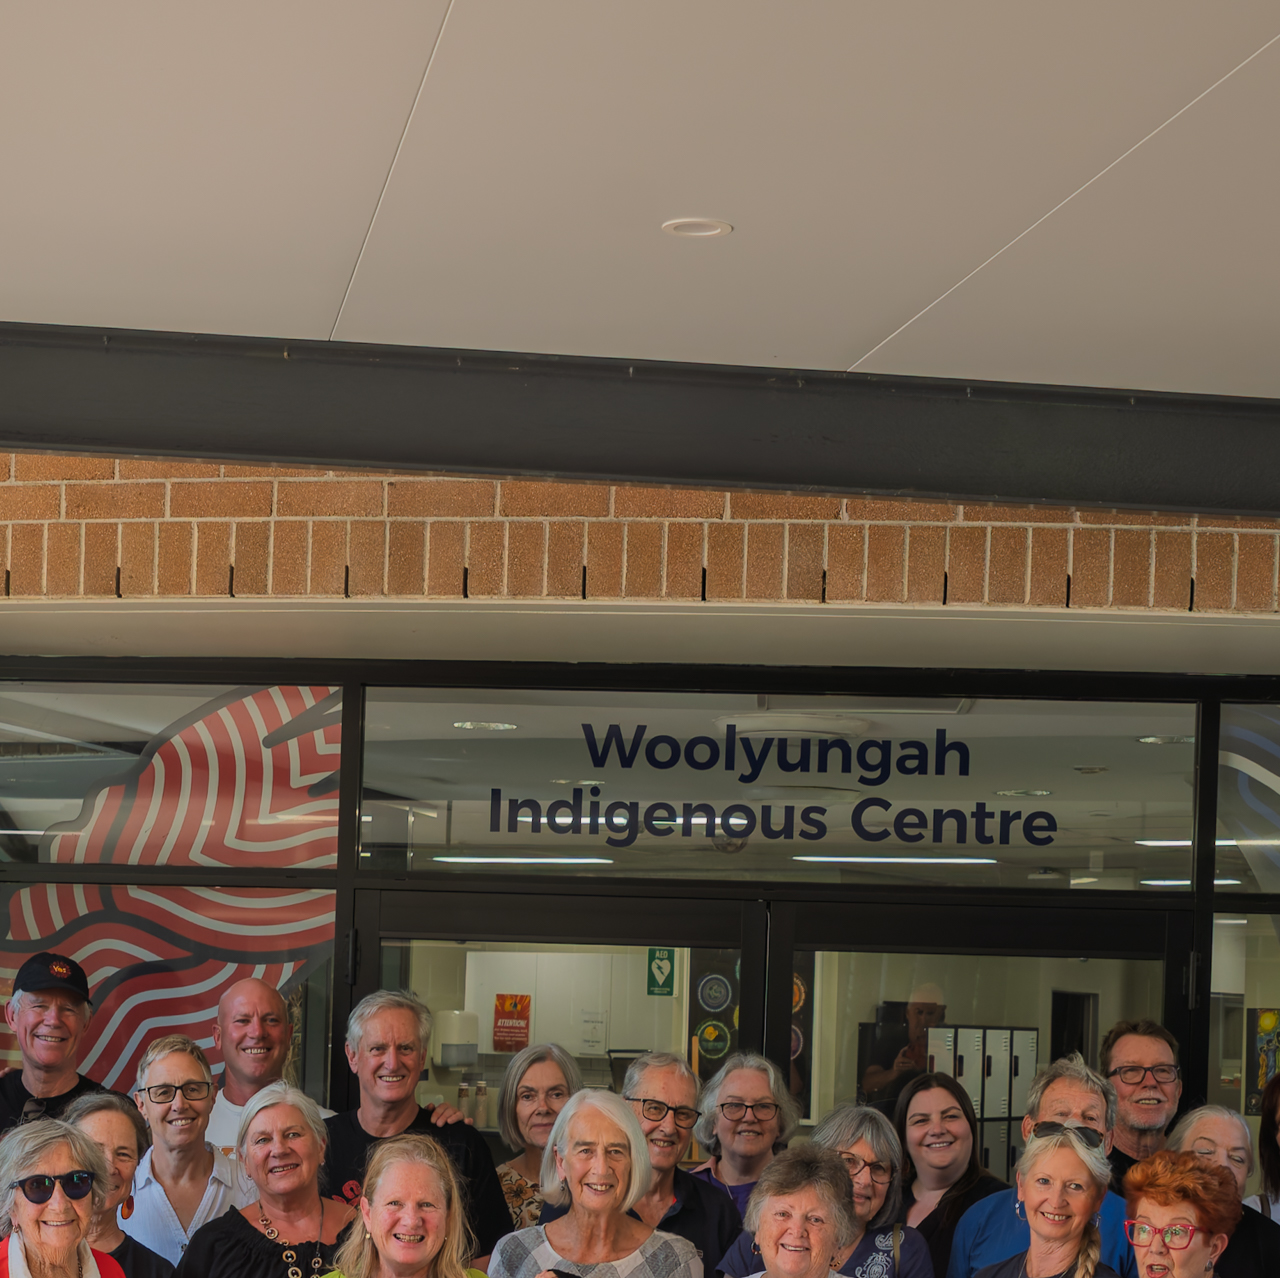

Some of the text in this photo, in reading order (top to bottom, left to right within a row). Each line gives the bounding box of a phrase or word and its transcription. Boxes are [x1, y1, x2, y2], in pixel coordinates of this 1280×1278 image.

[580, 723, 971, 786] Woolyungah
[488, 785, 1058, 848] Indigenous Centre
[655, 951, 668, 959] AED
